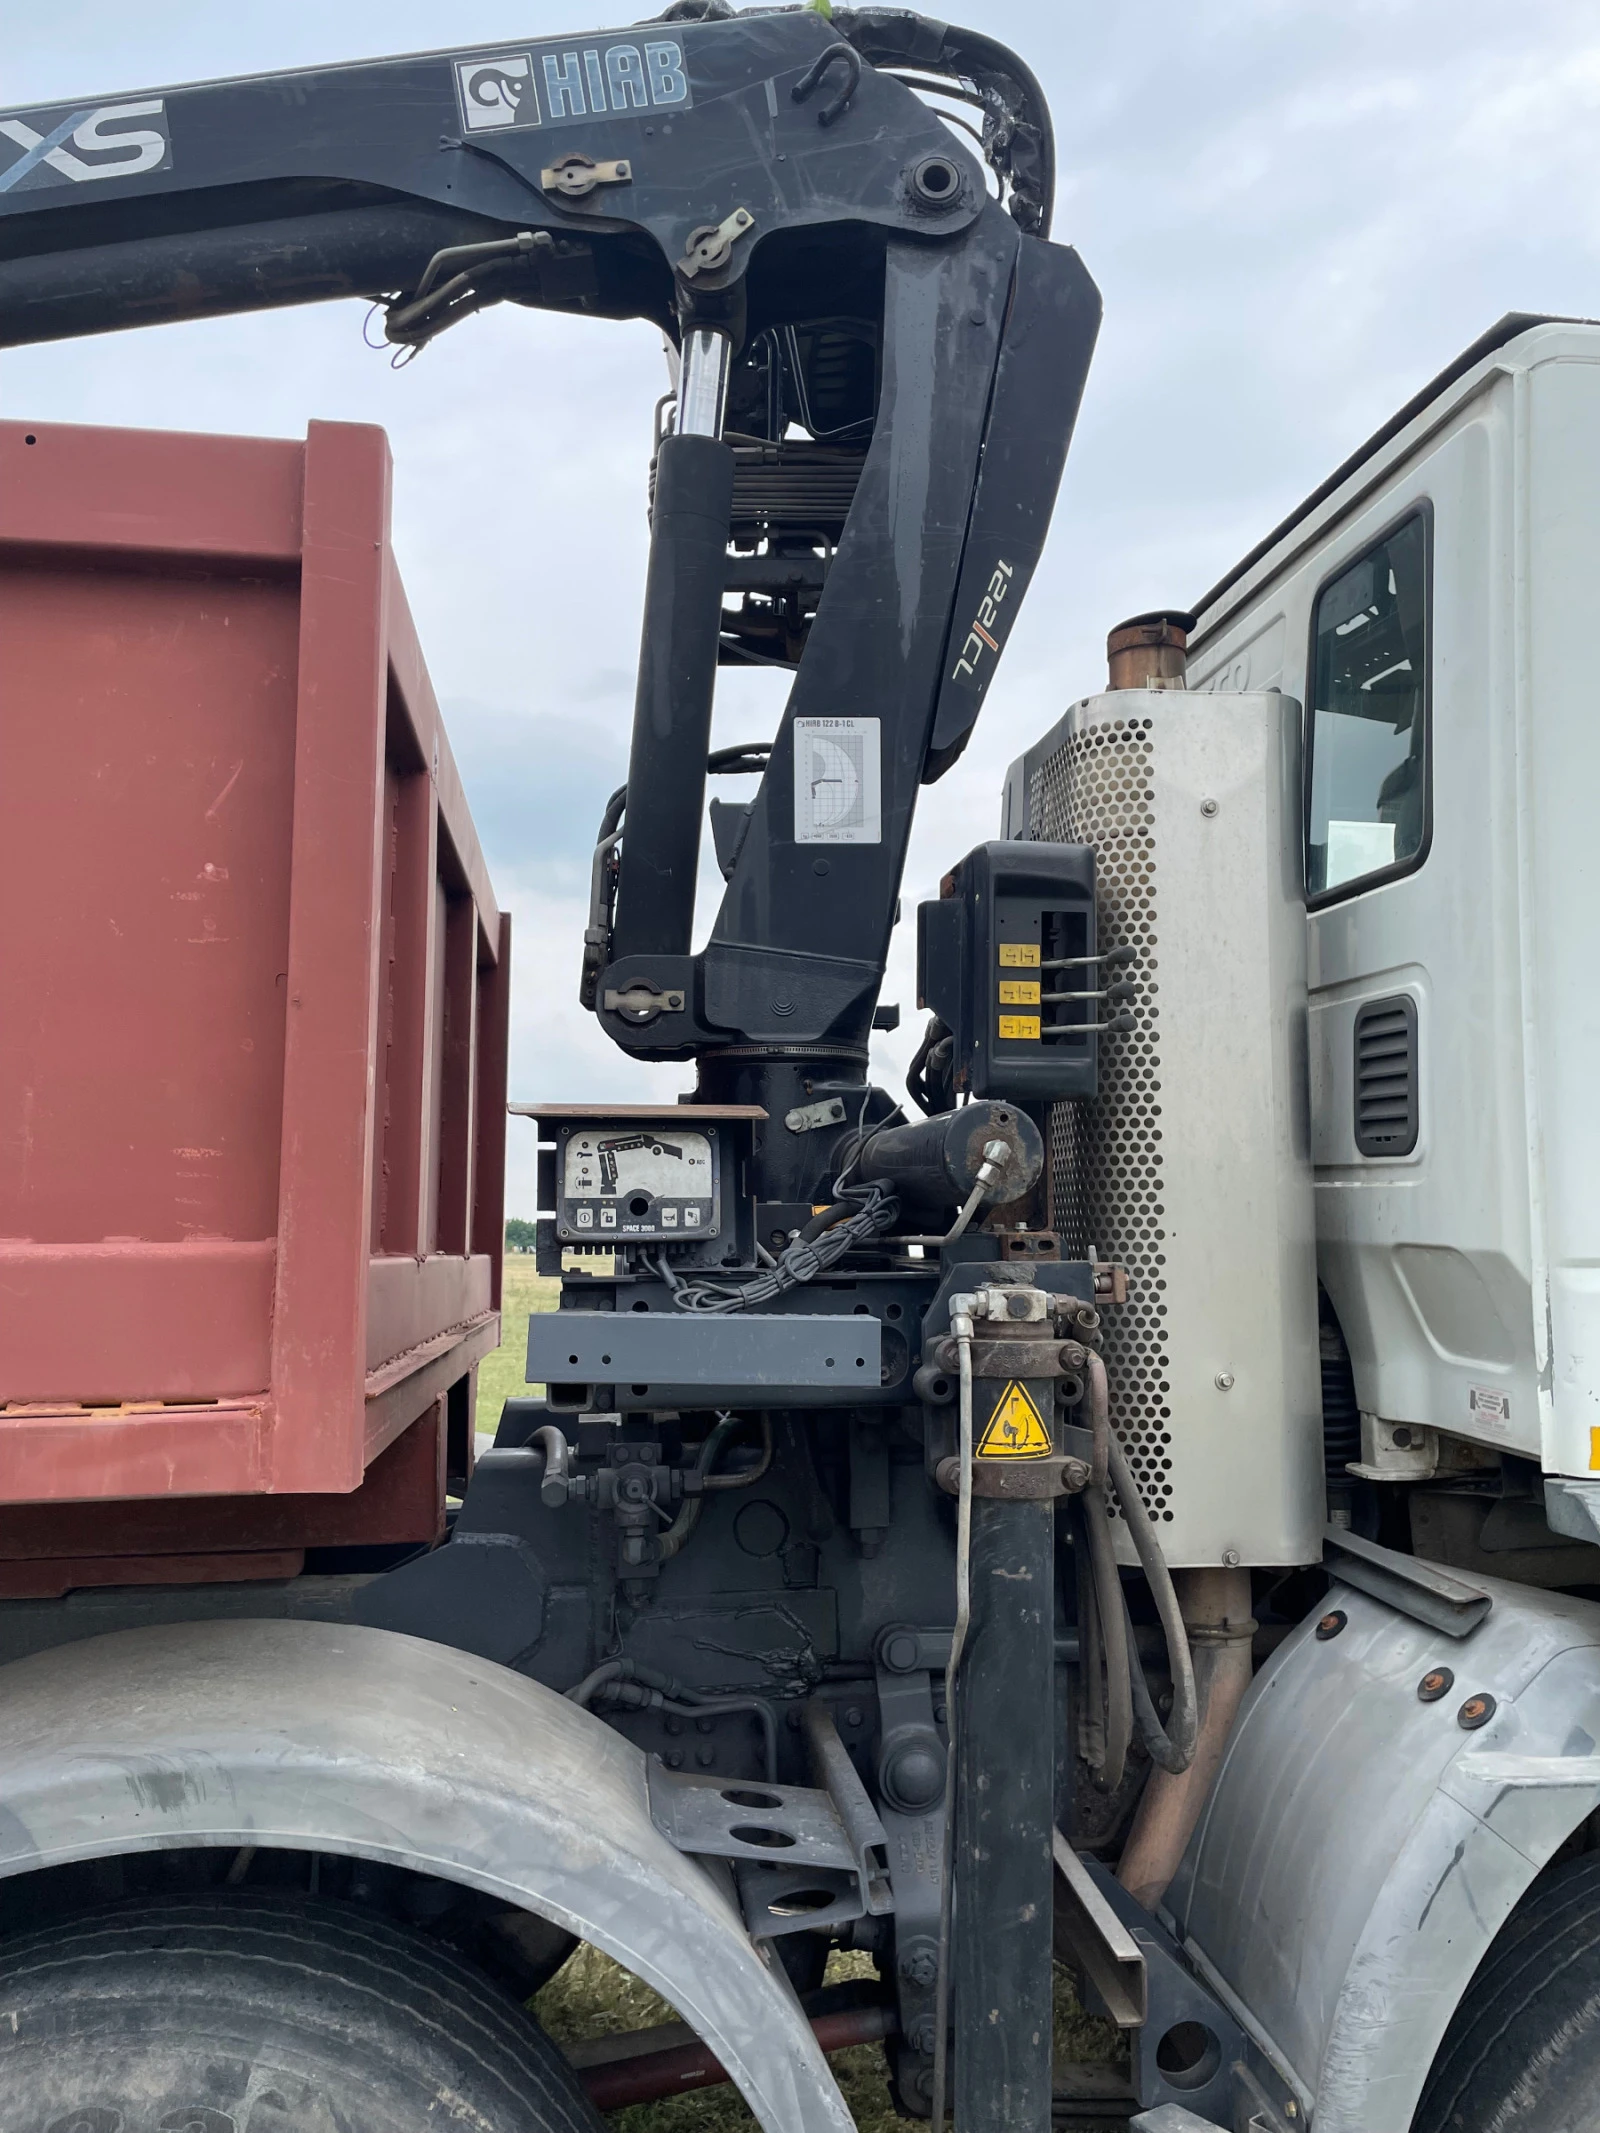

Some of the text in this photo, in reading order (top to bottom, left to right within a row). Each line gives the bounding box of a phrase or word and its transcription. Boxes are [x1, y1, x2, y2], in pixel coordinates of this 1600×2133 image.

[542, 41, 688, 118] HIAB
[0, 99, 166, 193] XS
[822, 719, 834, 728] 122
[846, 719, 855, 728] CL
[622, 1224, 655, 1232] SPACE 3000
